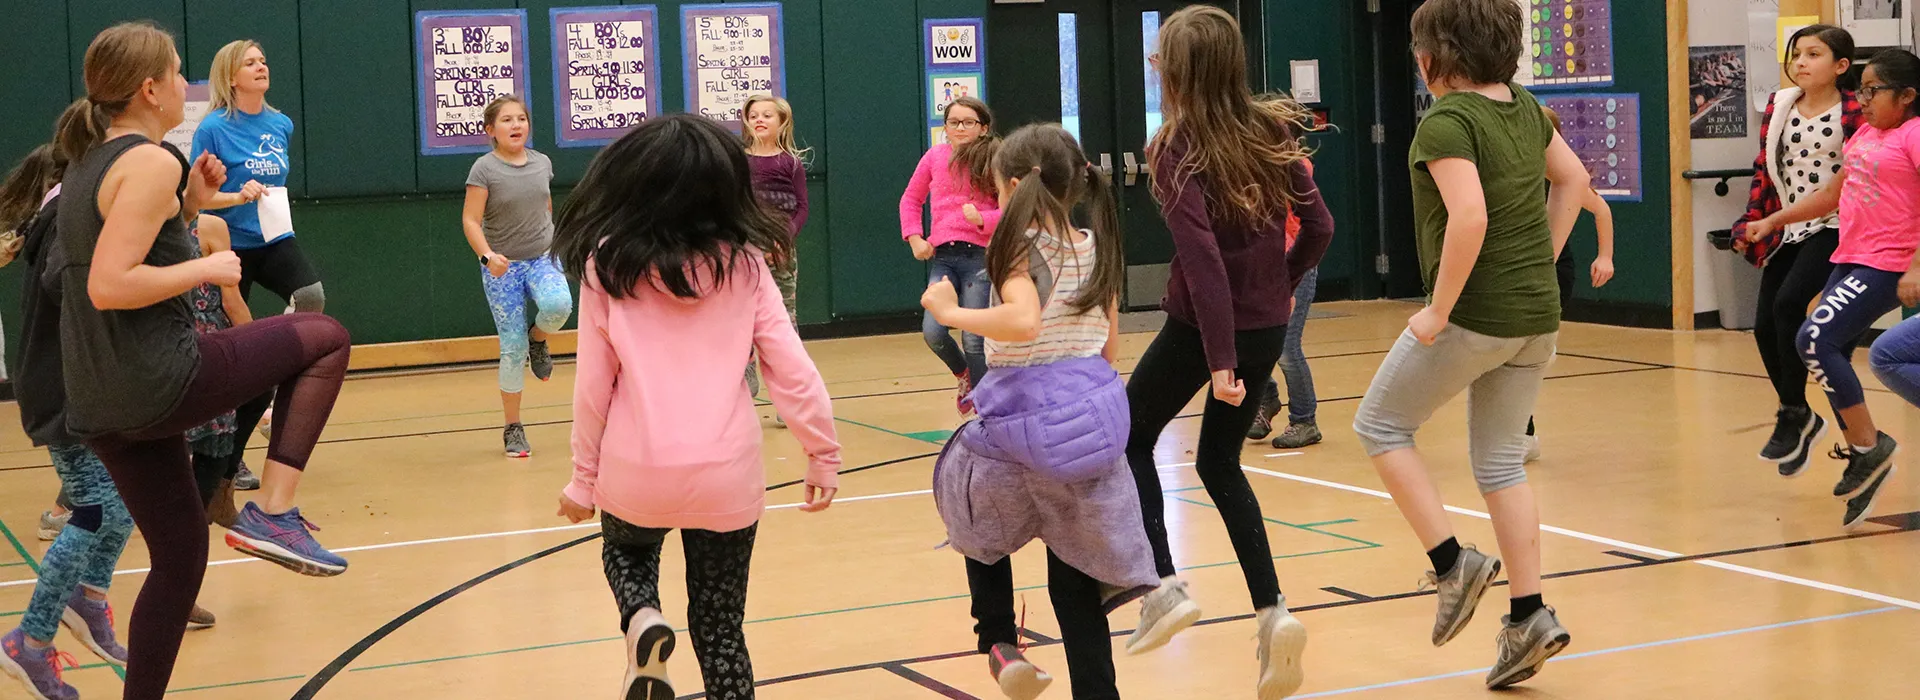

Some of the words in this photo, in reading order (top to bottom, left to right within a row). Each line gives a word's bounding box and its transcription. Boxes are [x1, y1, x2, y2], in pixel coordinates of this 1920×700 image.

[435, 43, 462, 55] FALL
[569, 38, 595, 50] FALL
[935, 46, 972, 58] WOW
[434, 66, 471, 80] SPRING
[569, 61, 602, 76] SPRING
[721, 68, 749, 79] GIRLS
[454, 80, 494, 94] GIRLS
[592, 75, 632, 87] GIRLS
[571, 88, 594, 100] FALL
[437, 94, 463, 108] FALL
[1714, 103, 1736, 112] There
[571, 114, 608, 129] SPRING
[1707, 114, 1714, 123] is
[1728, 112, 1733, 122] I
[1735, 114, 1743, 122] in
[437, 122, 475, 136] SPRING
[244, 158, 273, 169] Girls
[260, 166, 281, 176] run
